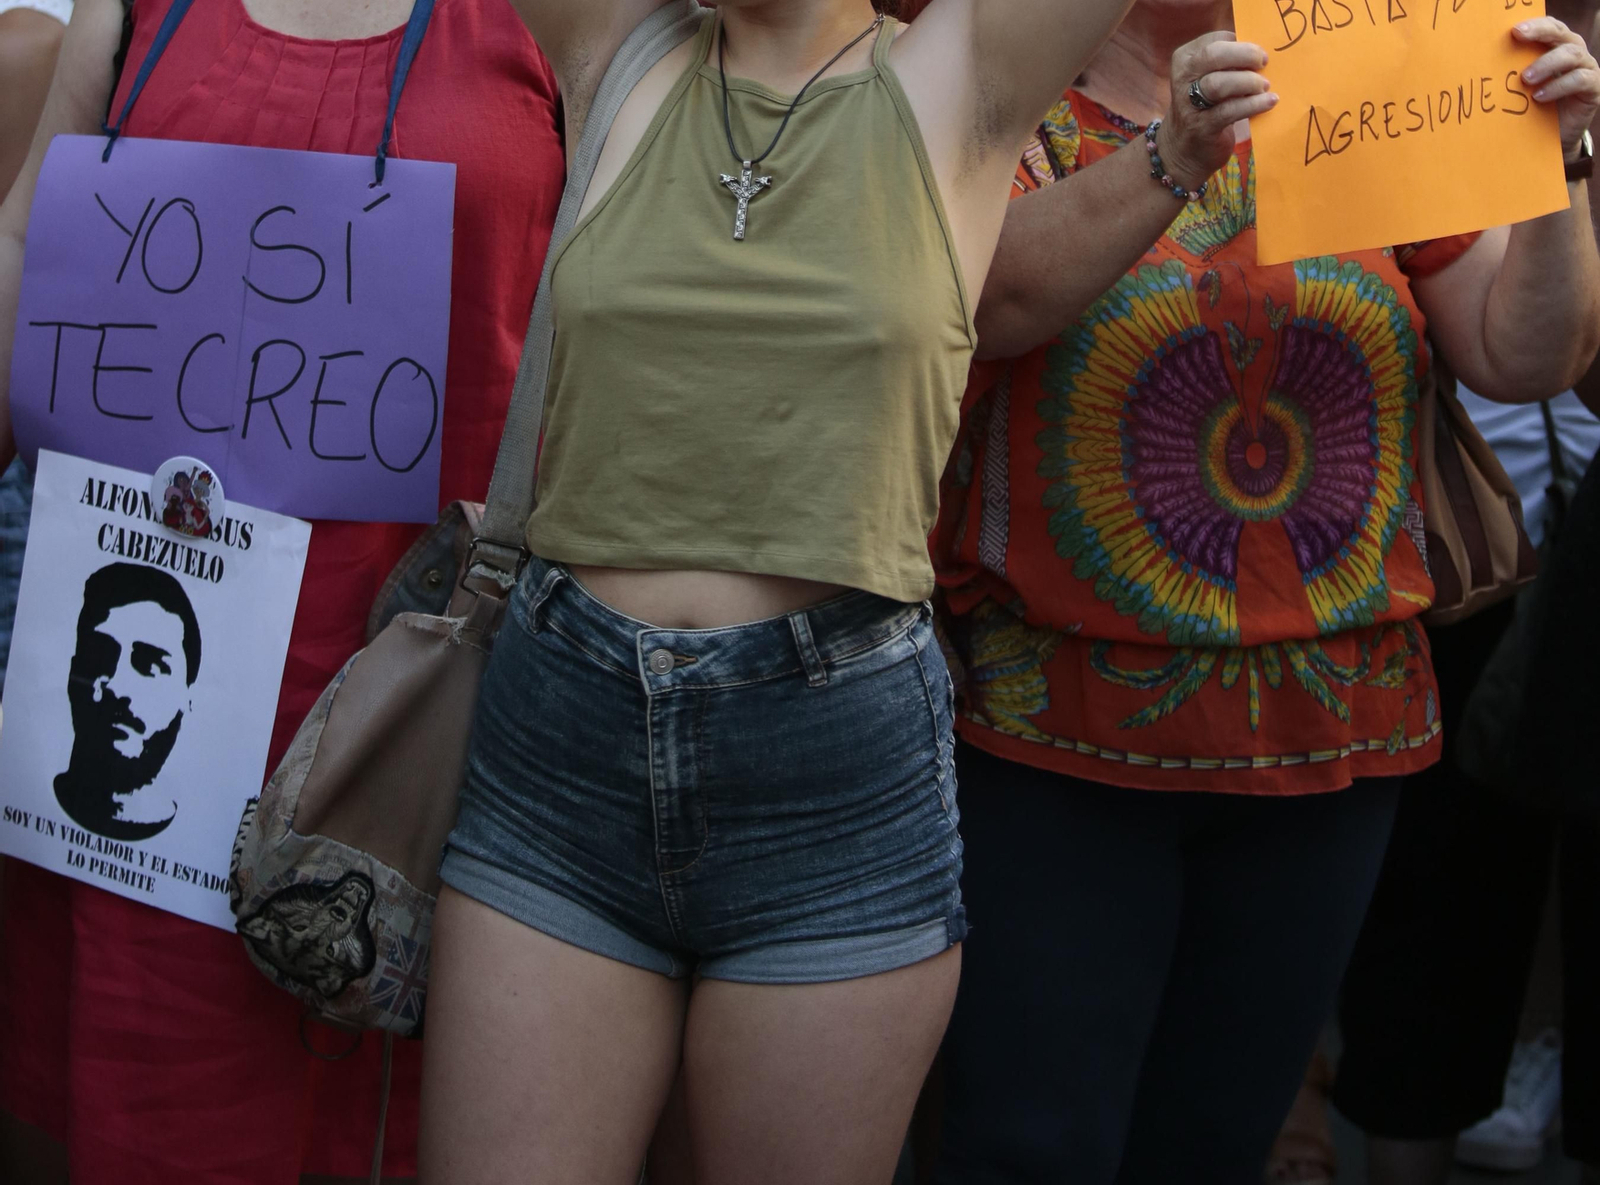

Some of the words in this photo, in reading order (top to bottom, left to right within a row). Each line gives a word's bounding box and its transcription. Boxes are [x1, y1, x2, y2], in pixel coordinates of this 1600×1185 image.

[1303, 69, 1531, 167] AGRESIONES
[94, 192, 204, 295] YO
[242, 192, 392, 305] SÍ
[79, 477, 160, 524] ALFON
[97, 522, 225, 584] CABEZUELO
[2, 804, 33, 828] SOY
[35, 816, 57, 838] UN
[60, 825, 135, 864] VIOLADOR
[138, 850, 149, 868] Y
[150, 855, 169, 876] EL
[171, 862, 231, 896] ESTADO
[66, 849, 86, 869] LO
[88, 856, 157, 894] PERMITE
